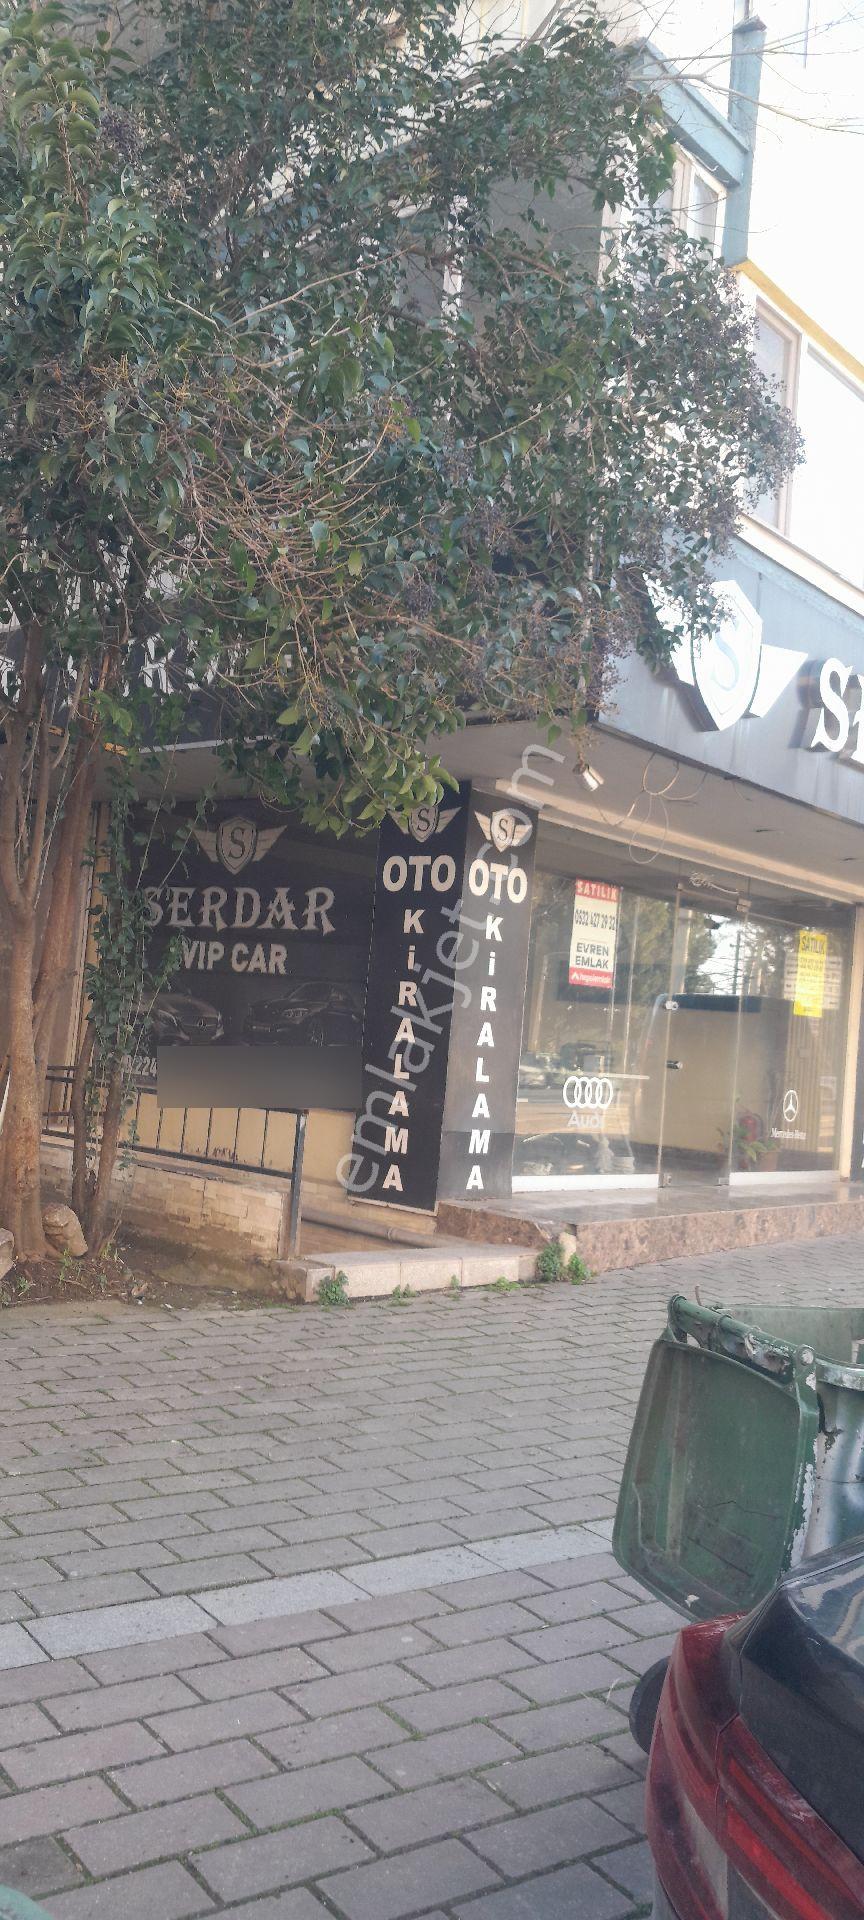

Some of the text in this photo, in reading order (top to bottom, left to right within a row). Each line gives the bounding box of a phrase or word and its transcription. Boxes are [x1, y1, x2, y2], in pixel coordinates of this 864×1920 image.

[811, 657, 864, 766] S
[418, 807, 431, 832] S
[227, 826, 246, 860] S
[382, 854, 456, 892] OTO
[468, 858, 528, 904] OTO
[143, 885, 337, 936] SERDAR
[181, 940, 288, 975] VIP CAR
[575, 955, 609, 970] EMLAK
[576, 942, 609, 957] EVREN
[567, 1110, 606, 1128] Audi
